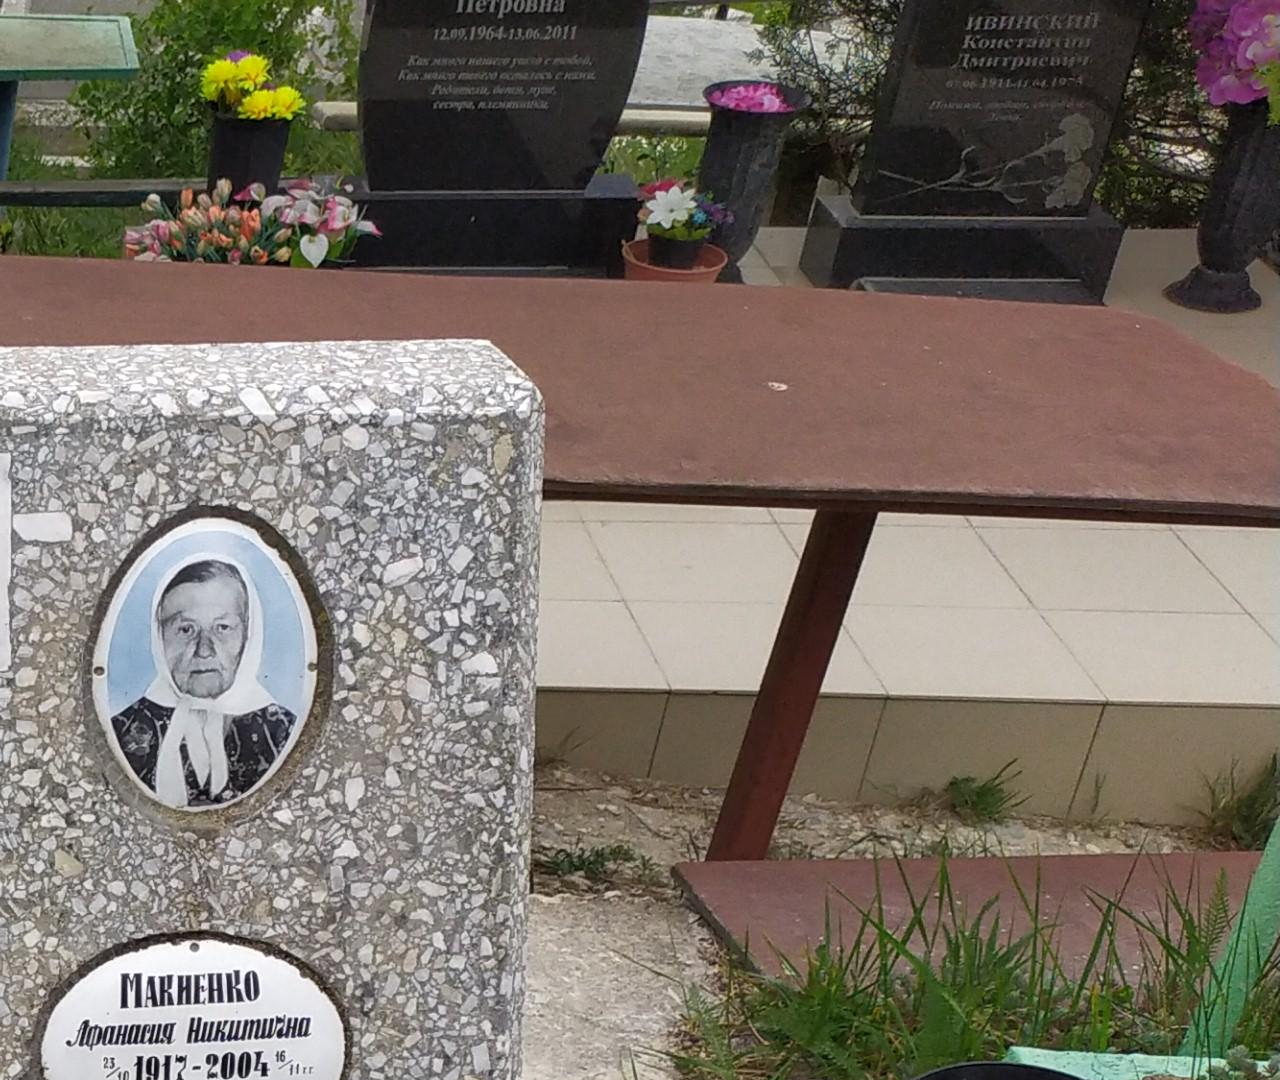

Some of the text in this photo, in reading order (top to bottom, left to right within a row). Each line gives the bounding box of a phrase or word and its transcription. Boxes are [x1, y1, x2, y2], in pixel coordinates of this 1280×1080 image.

[455, 0, 565, 18] Петровна
[65, 1014, 312, 1051] Афанасия Никитична
